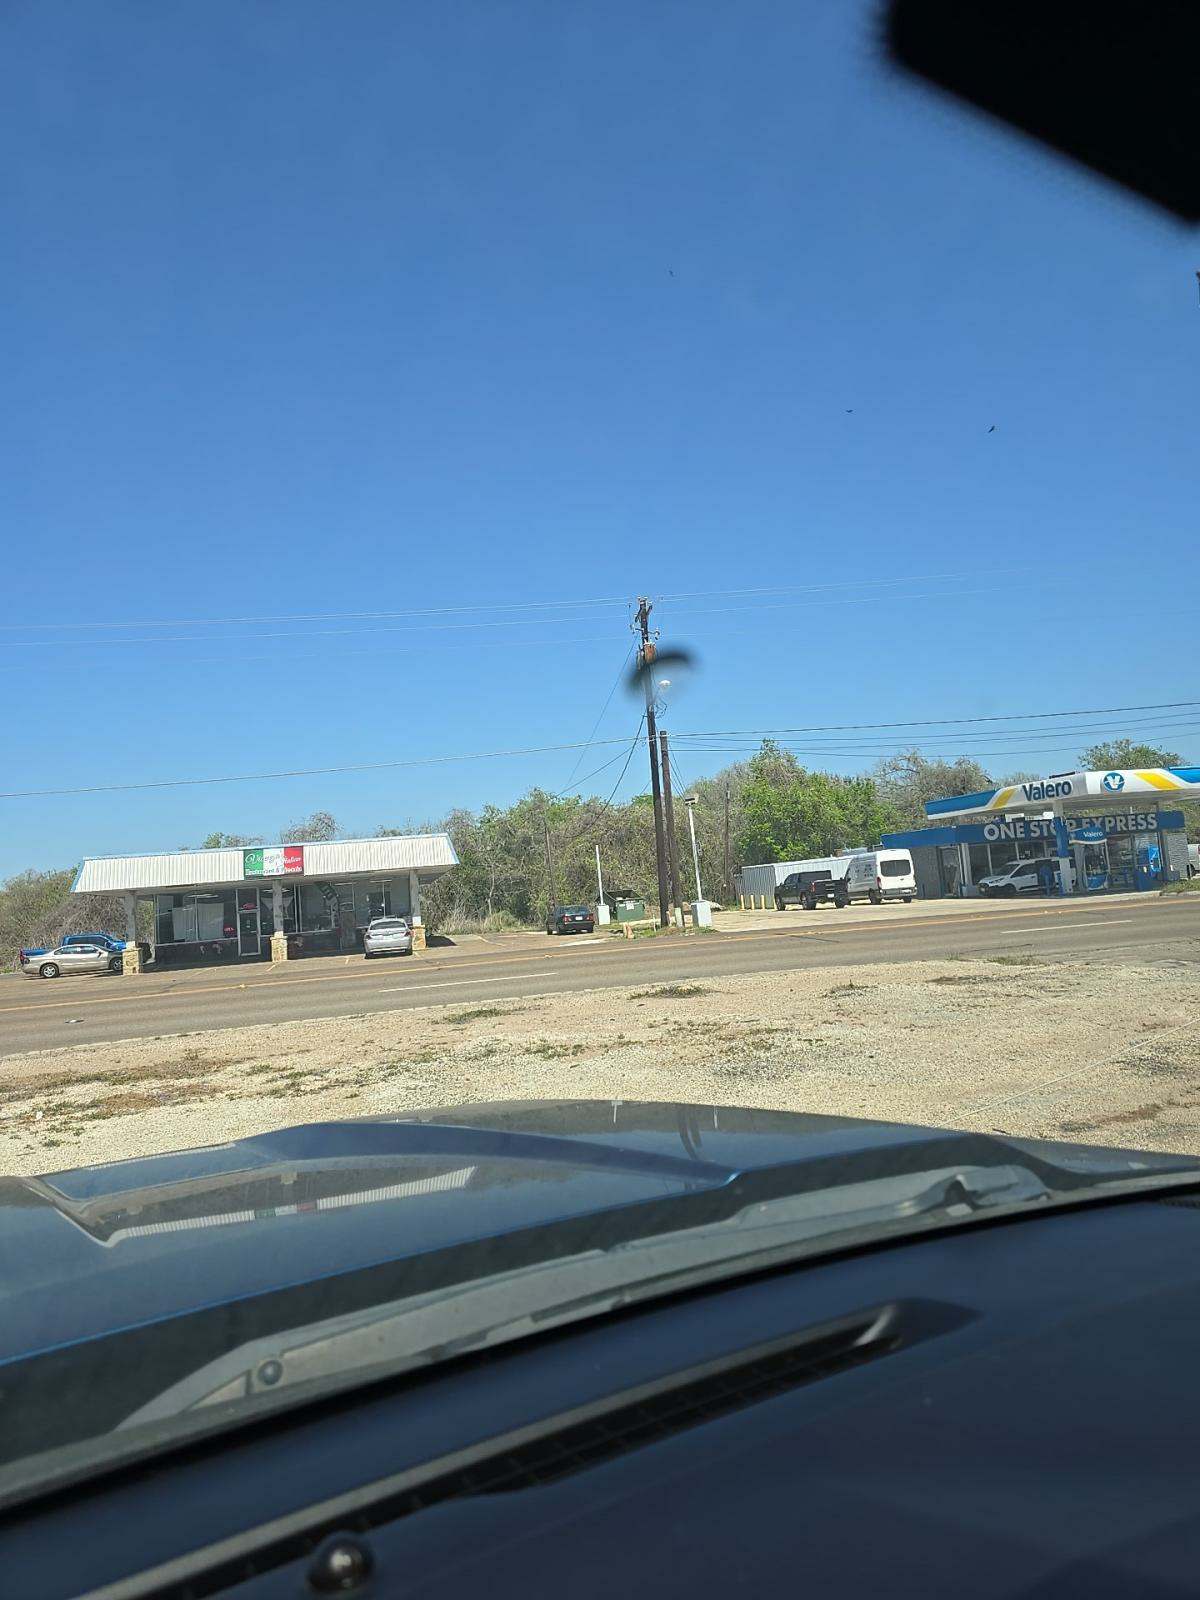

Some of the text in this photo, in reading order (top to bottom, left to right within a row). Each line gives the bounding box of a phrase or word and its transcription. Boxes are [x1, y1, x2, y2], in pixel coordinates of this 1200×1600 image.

[1022, 780, 1073, 801] Valero
[983, 821, 1026, 841] ONE
[1081, 813, 1158, 832] EXPRESS
[1083, 830, 1104, 838] Valero
